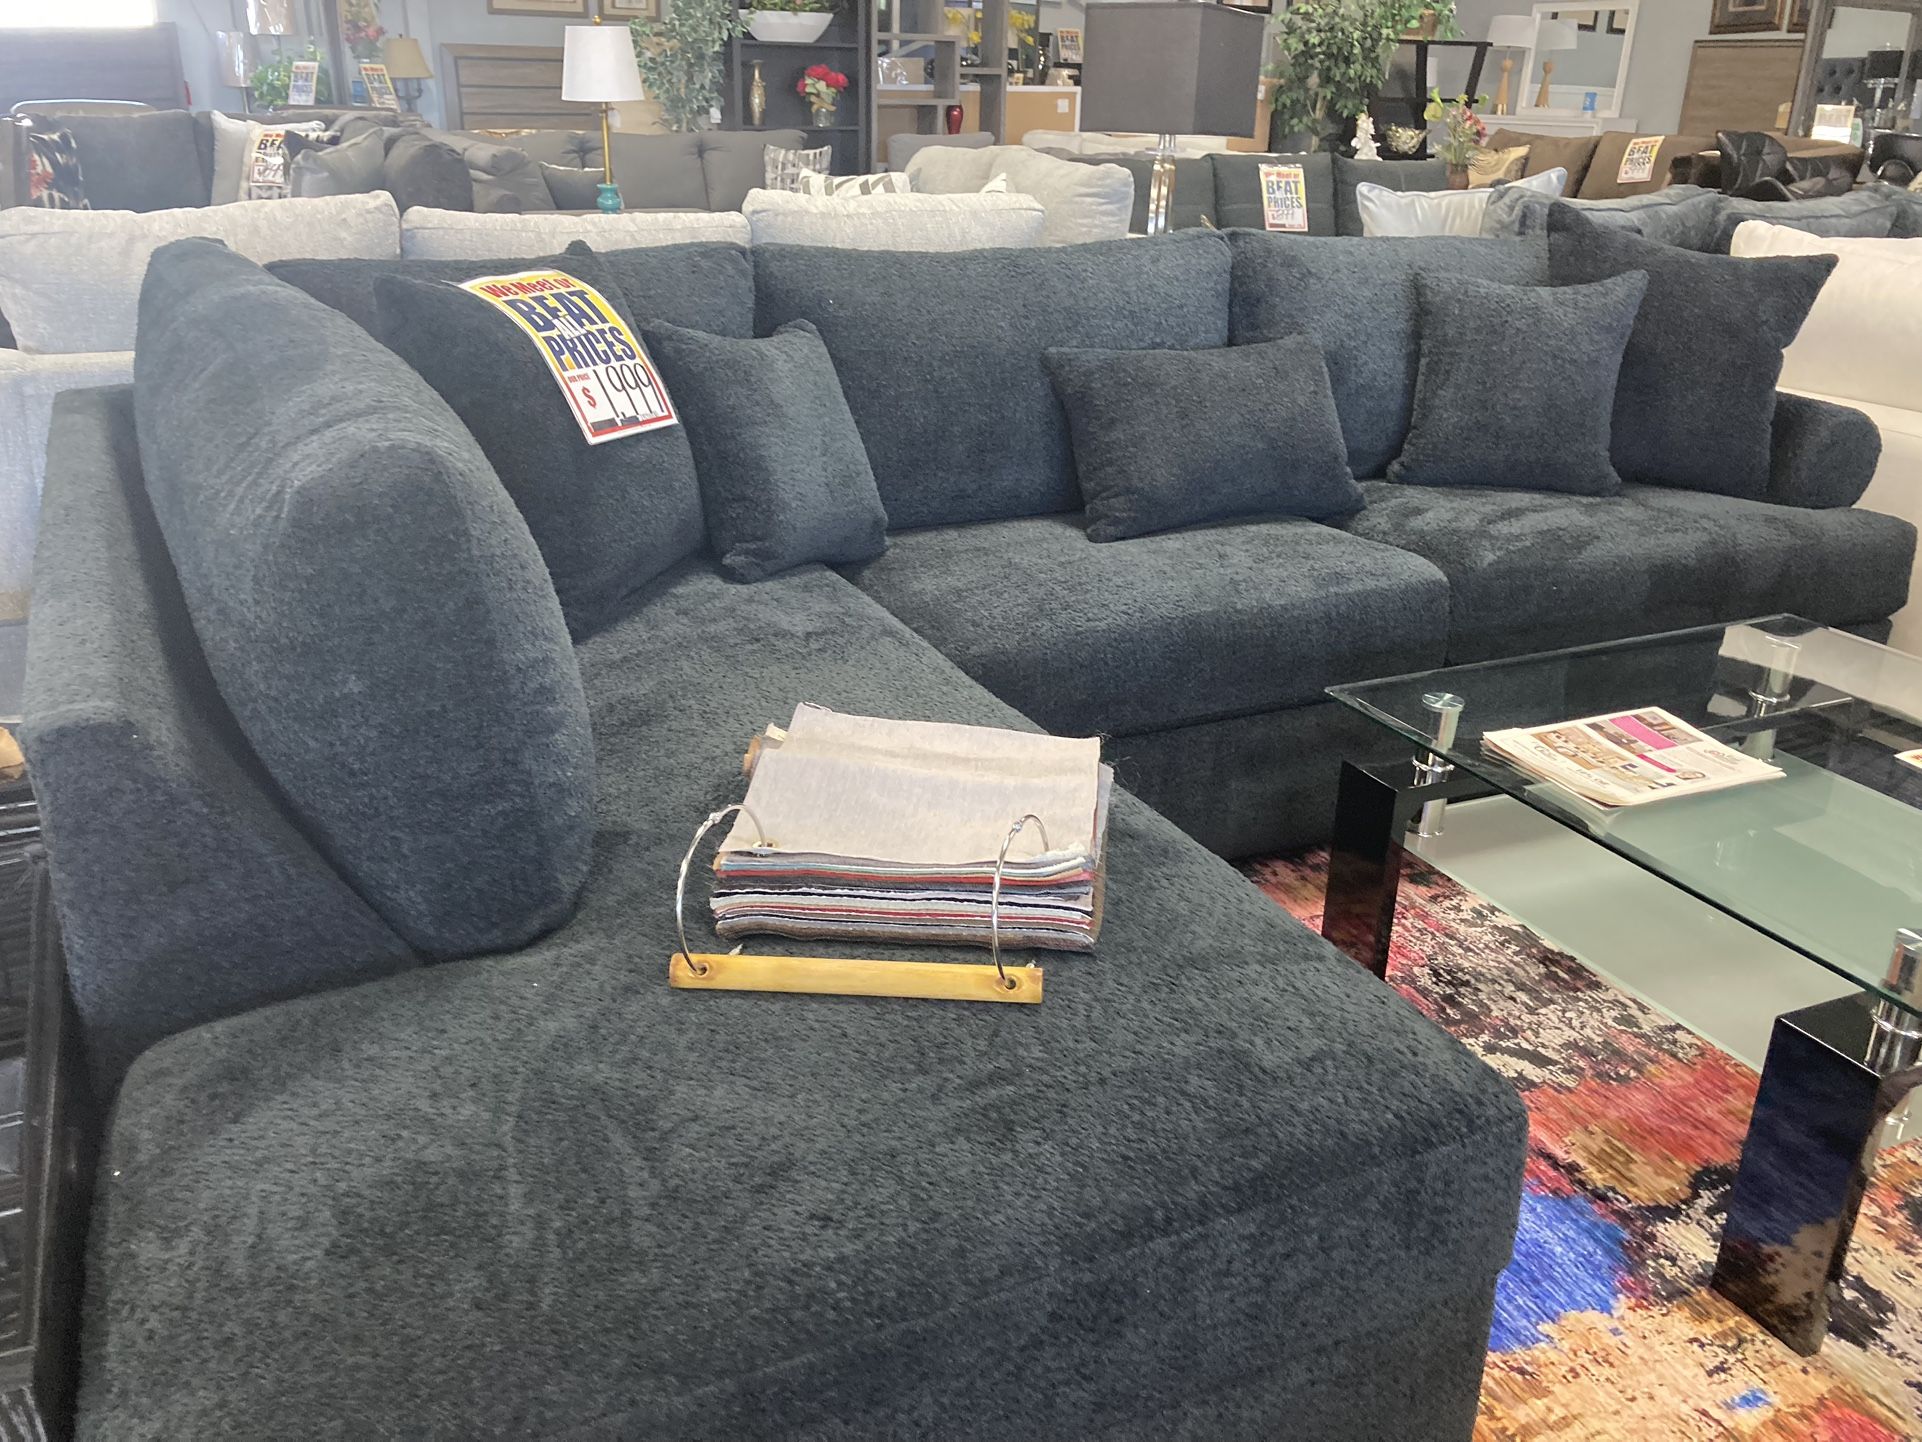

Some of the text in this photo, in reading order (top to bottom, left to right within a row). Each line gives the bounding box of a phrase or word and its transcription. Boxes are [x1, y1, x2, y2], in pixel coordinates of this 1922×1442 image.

[1266, 180, 1301, 195] BEAT
[1267, 196, 1303, 209] PRICES
[480, 277, 576, 298] We Meet or
[502, 289, 610, 333] BEAT
[552, 314, 588, 340] ALL
[542, 325, 638, 372] PRICES
